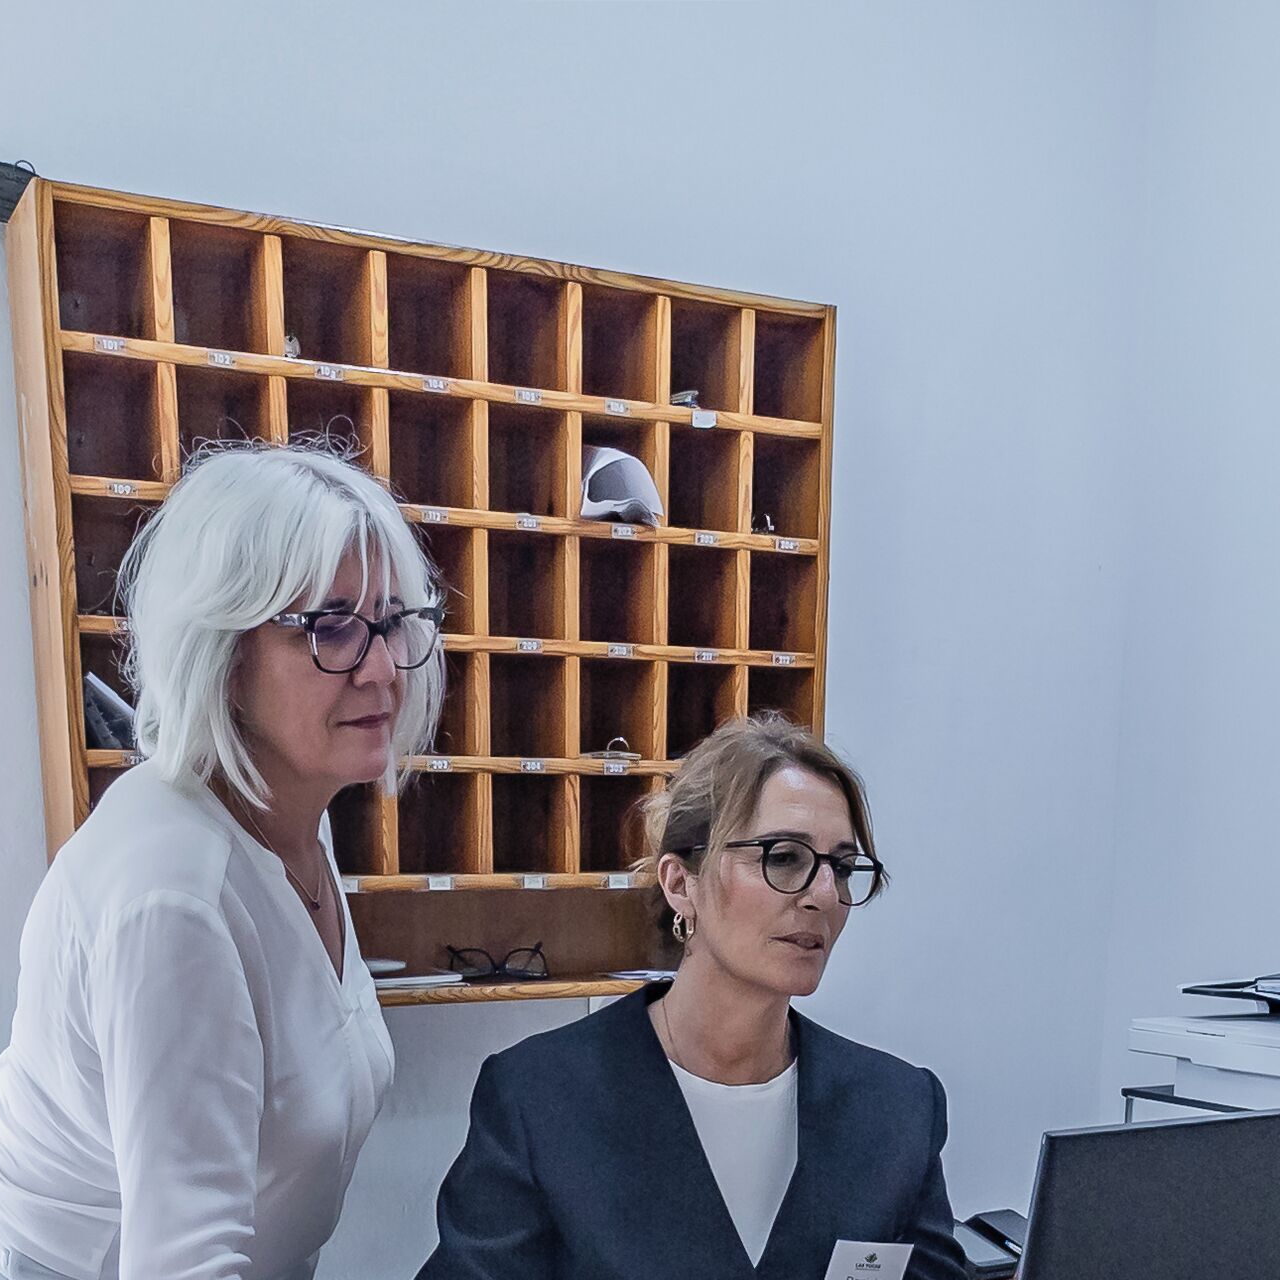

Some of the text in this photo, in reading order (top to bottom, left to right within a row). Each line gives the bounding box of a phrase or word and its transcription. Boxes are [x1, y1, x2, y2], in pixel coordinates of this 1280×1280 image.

[102, 338, 118, 351] 101
[213, 352, 230, 365] 102
[429, 379, 444, 390] 104
[113, 483, 131, 495] 109
